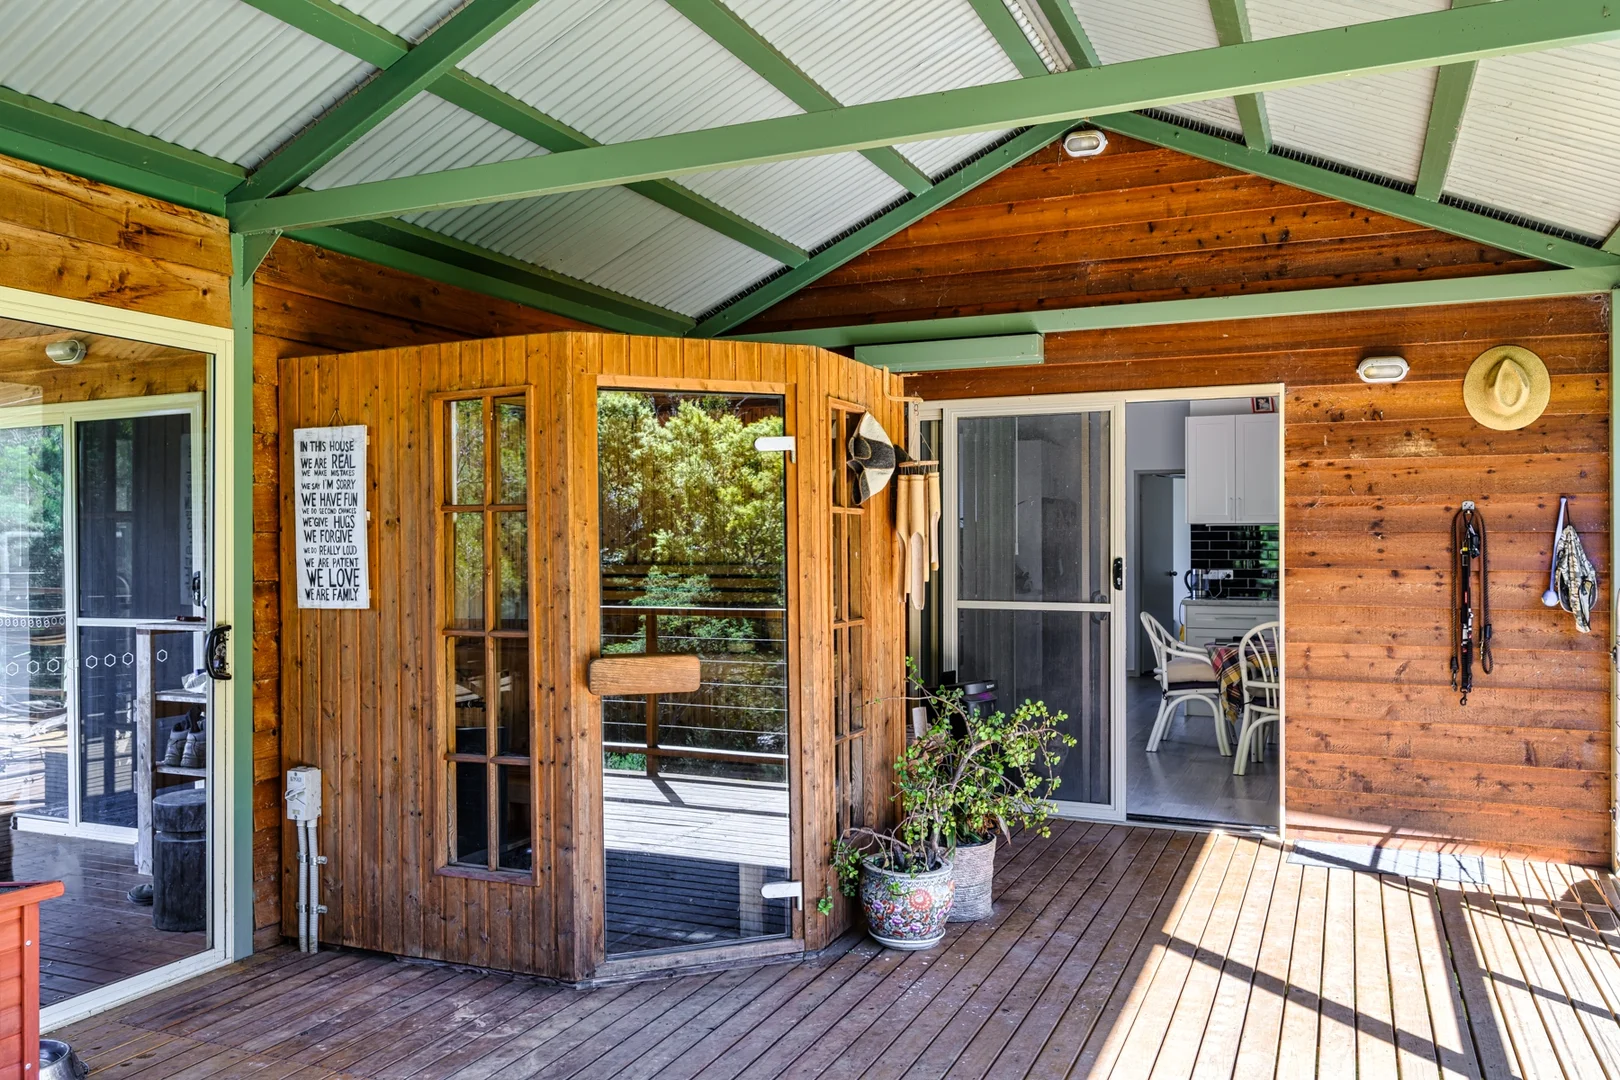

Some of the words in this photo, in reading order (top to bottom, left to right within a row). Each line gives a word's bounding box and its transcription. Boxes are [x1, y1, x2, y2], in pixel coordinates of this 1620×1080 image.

[300, 441, 308, 452] IN
[310, 441, 327, 452] THIS
[329, 440, 354, 452] HOUSE
[300, 458, 313, 469] WE
[314, 458, 327, 469] ARE
[331, 453, 356, 469] REAL
[301, 469, 311, 477] WE
[314, 469, 327, 477] MAKE
[330, 469, 355, 477] MISTAKES
[322, 479, 334, 490] I'M
[336, 478, 356, 490] SORRY
[301, 492, 317, 507] WE
[320, 492, 342, 507] HAVE
[344, 492, 358, 507] FUN
[302, 517, 312, 528] WE
[314, 517, 328, 528] GIVE
[334, 514, 356, 529] HUGS
[304, 529, 317, 544] WE
[320, 529, 353, 544] FORGIVE
[319, 545, 341, 556] REALLY
[342, 545, 358, 556] LOUD
[304, 558, 315, 568] WE
[318, 558, 330, 568] ARE
[332, 558, 359, 568] PATIENT
[306, 568, 324, 588] WE
[329, 568, 360, 588] LOVE
[304, 588, 315, 601] WE
[316, 588, 330, 601] ARE
[332, 588, 359, 602] FAMILY
